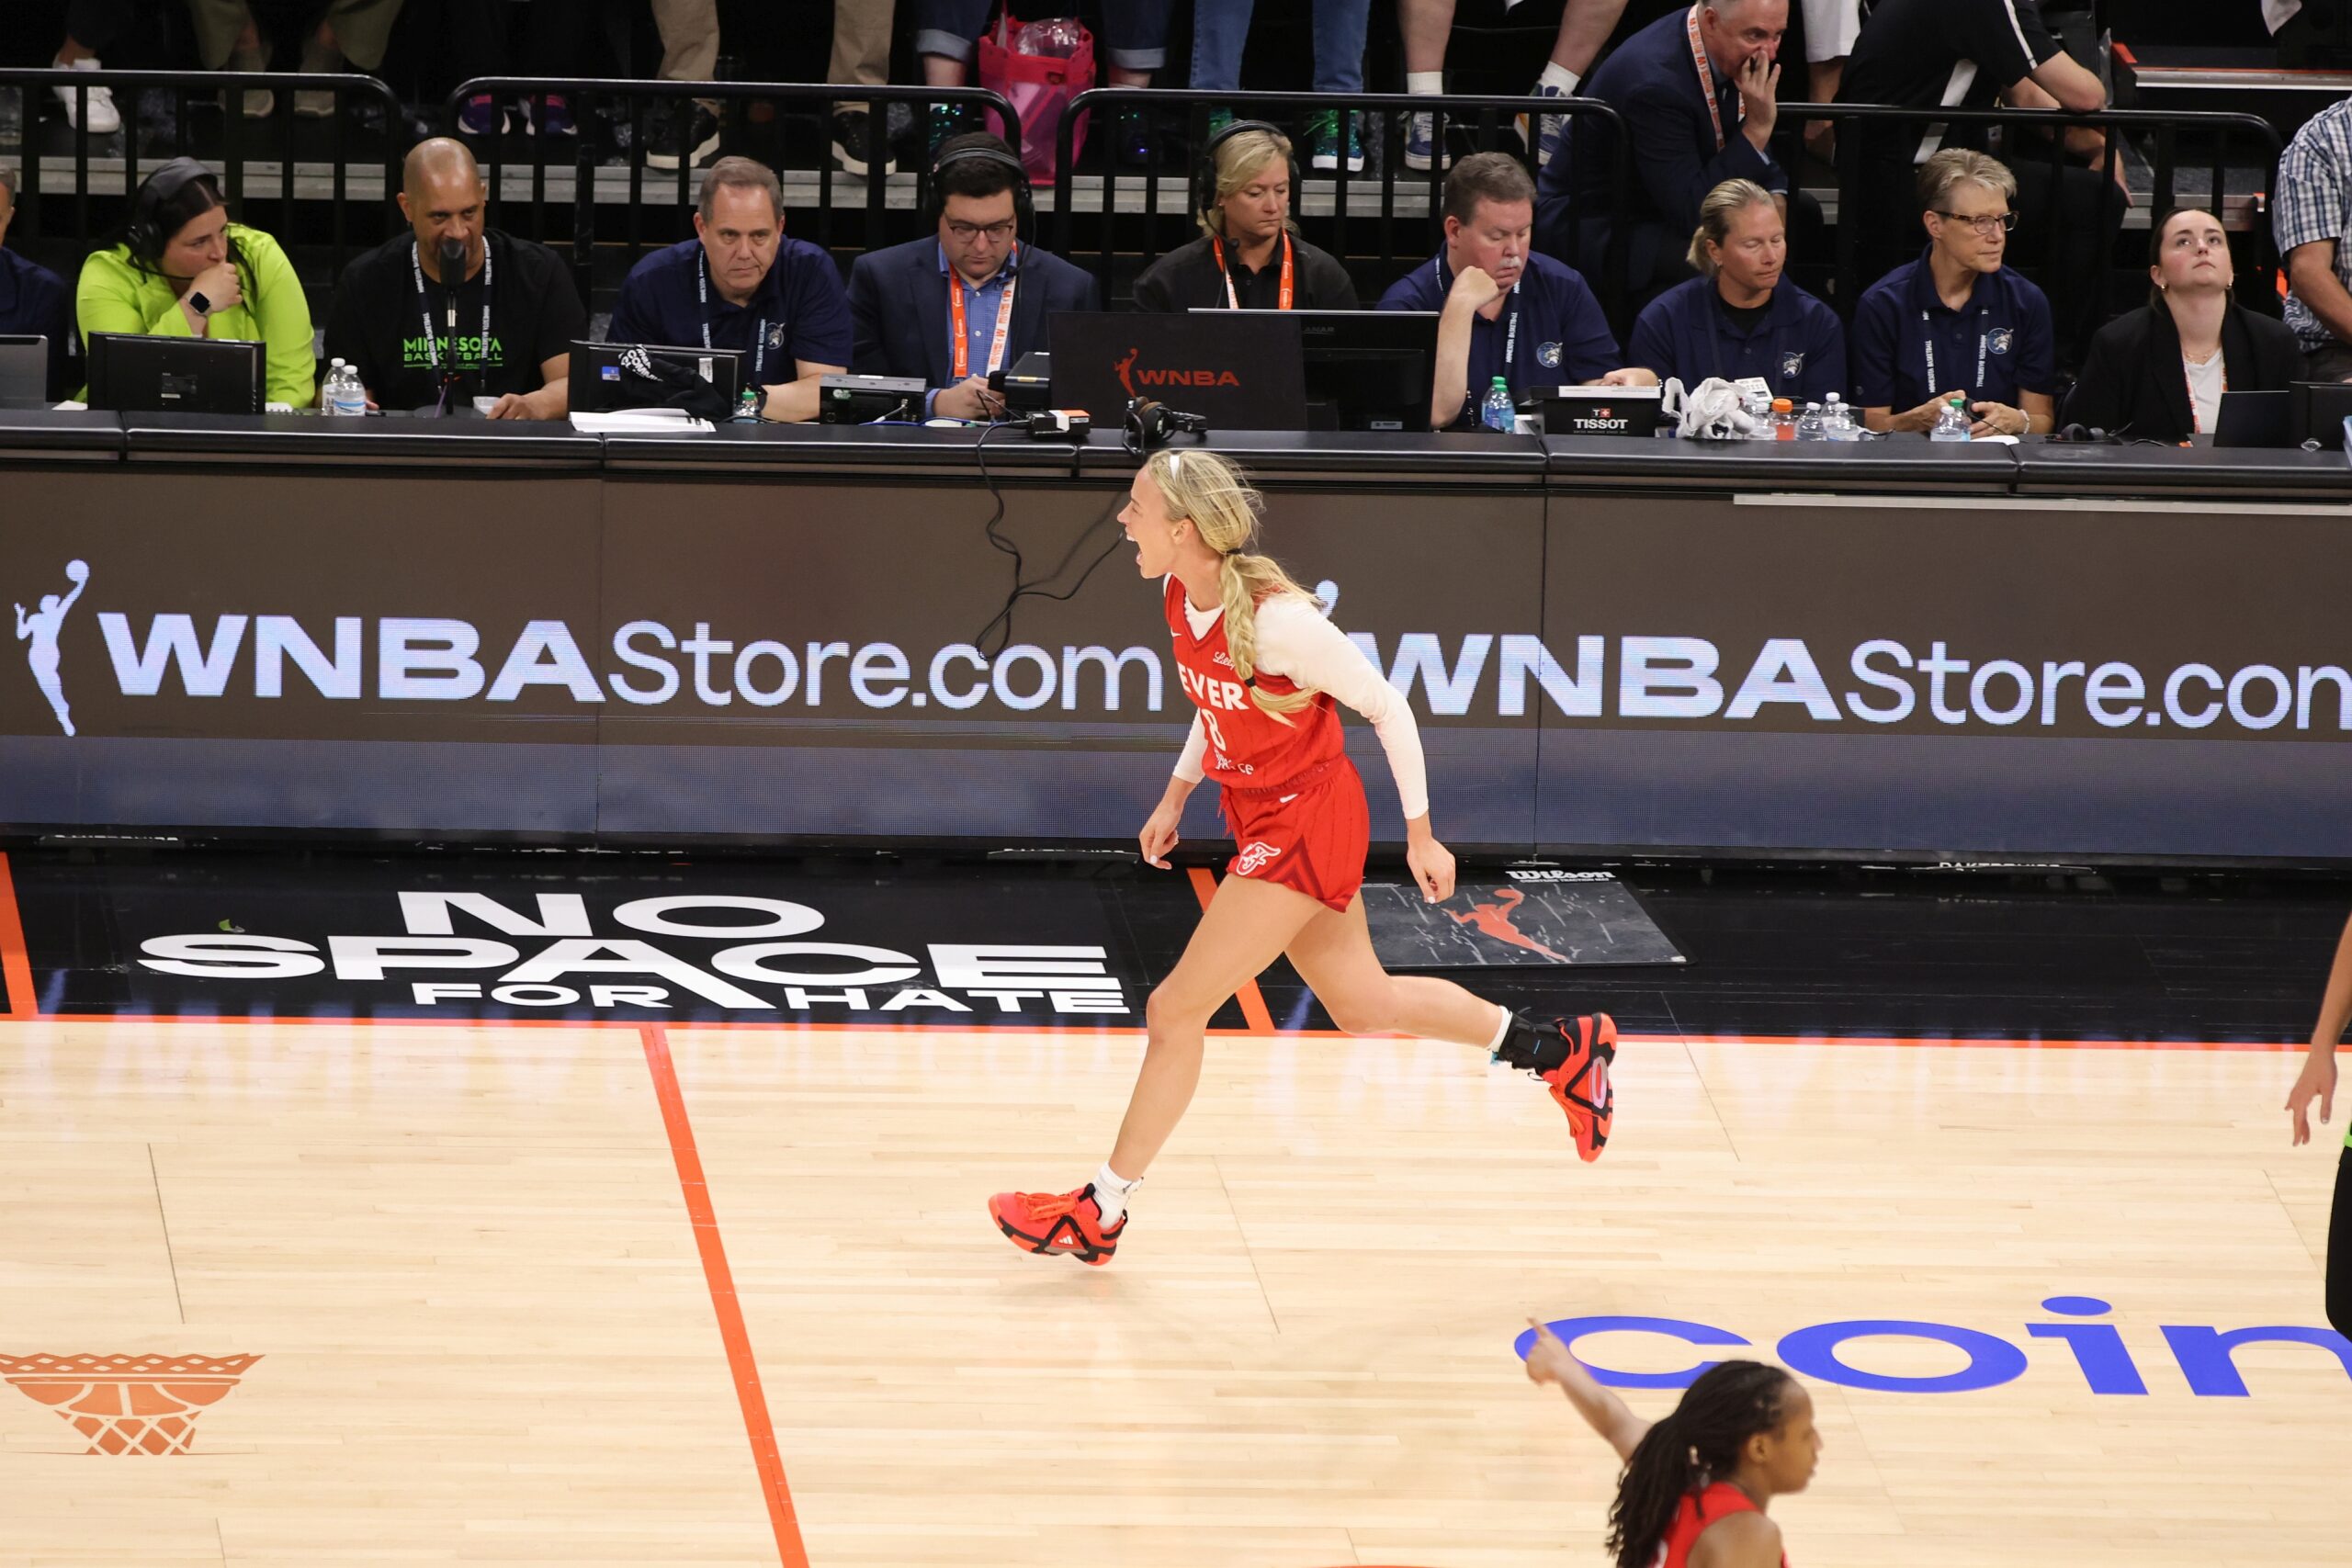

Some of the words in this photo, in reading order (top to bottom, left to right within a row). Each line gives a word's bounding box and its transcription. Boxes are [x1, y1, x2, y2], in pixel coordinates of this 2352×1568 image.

[403, 336, 503, 352] MINSOA
[403, 352, 503, 362] BASKTBAL
[1136, 369, 1240, 387] WNBA
[1573, 419, 1629, 429] TISSOT
[97, 613, 1164, 711] WNBAStore.com
[1505, 870, 1616, 880] Wilson
[397, 891, 825, 939] NO
[137, 933, 1122, 1009] SPACE
[412, 982, 673, 1008] FOR
[784, 987, 1131, 1014] HATE
